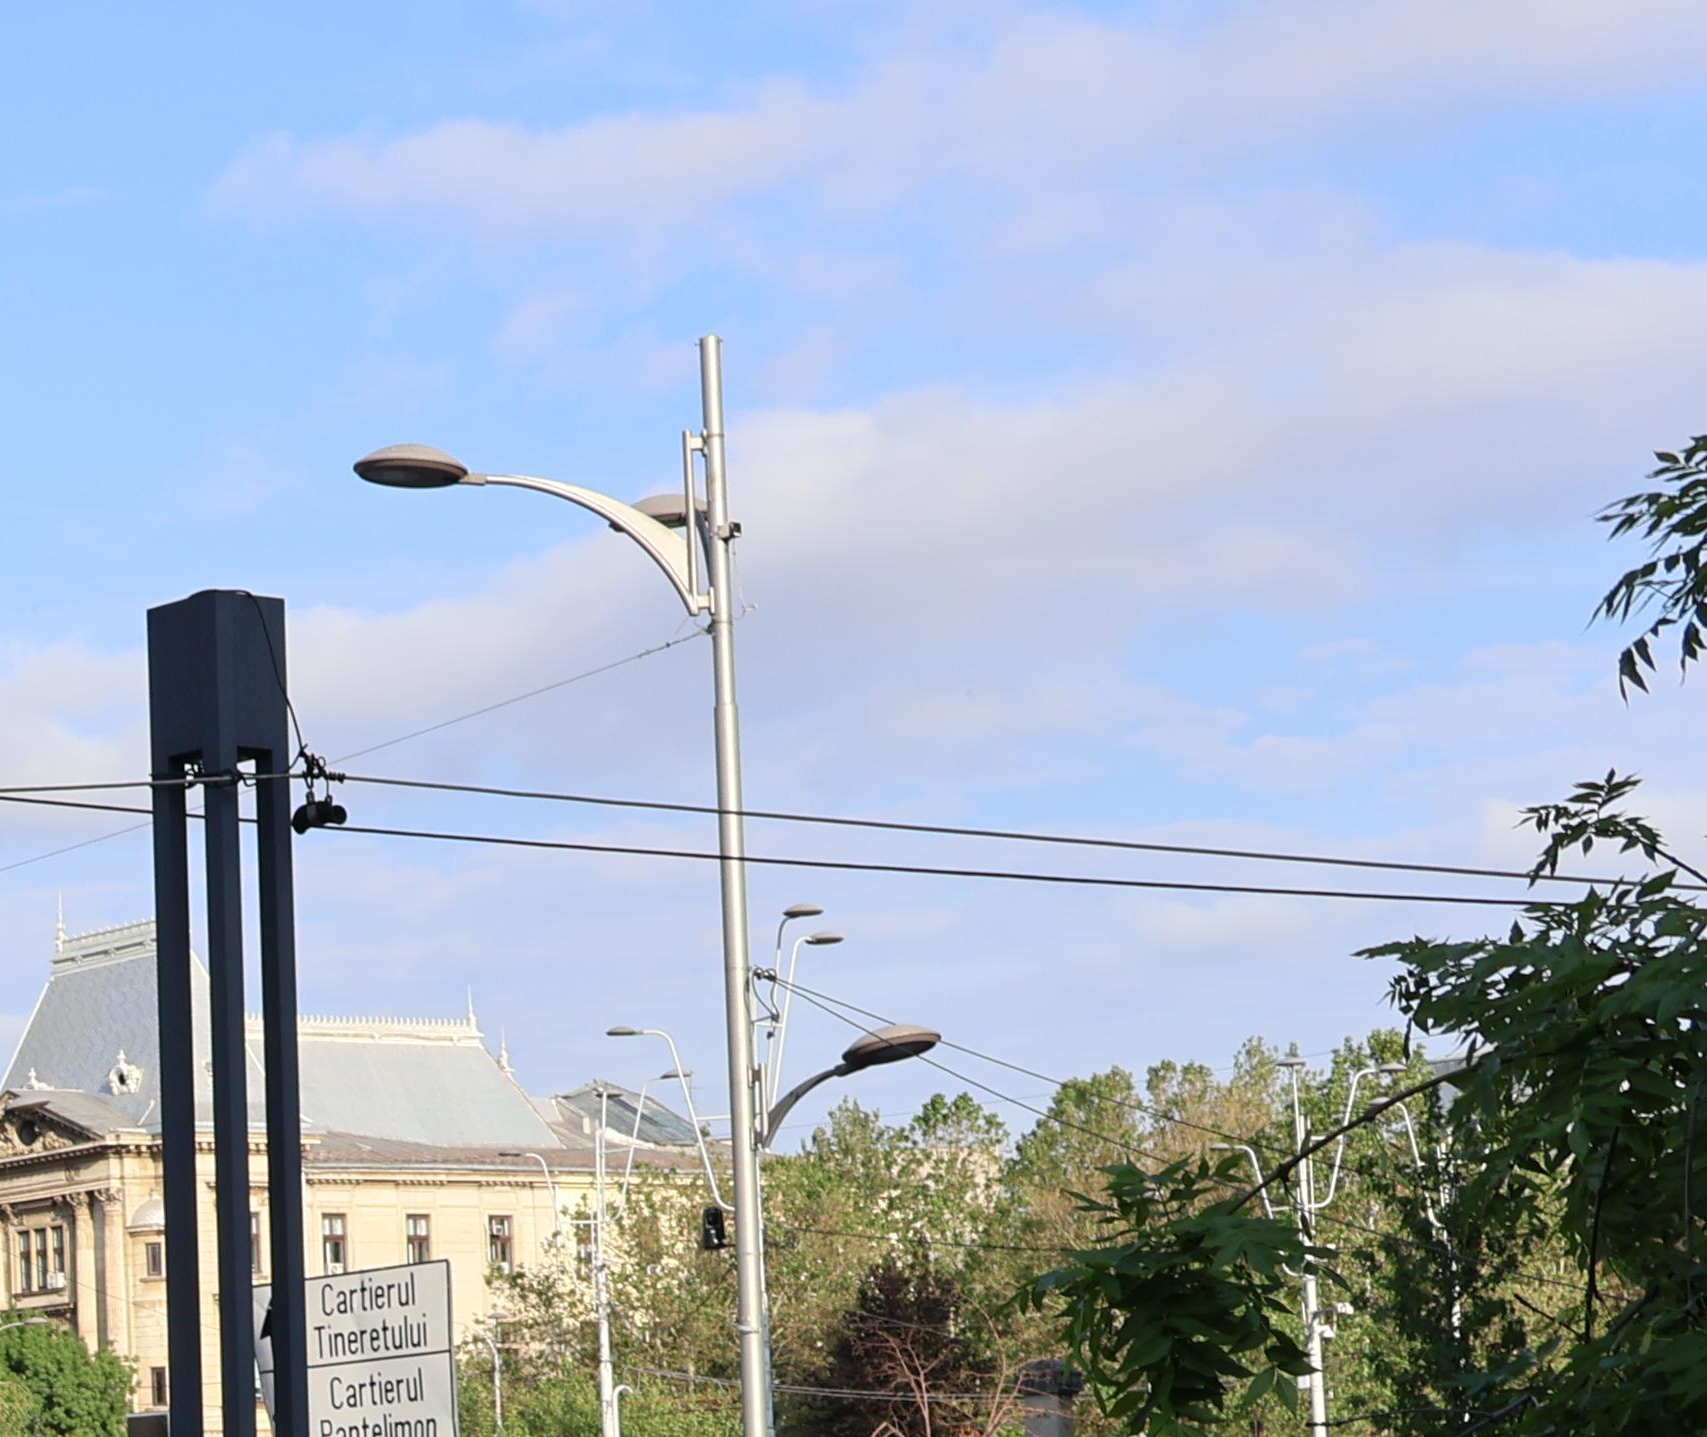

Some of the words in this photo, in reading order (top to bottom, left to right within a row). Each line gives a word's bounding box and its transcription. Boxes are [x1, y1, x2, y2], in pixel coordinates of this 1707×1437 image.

[320, 1271, 417, 1317] Cartierul
[313, 1313, 428, 1360] Tineretului
[329, 1367, 425, 1410] Cartierul
